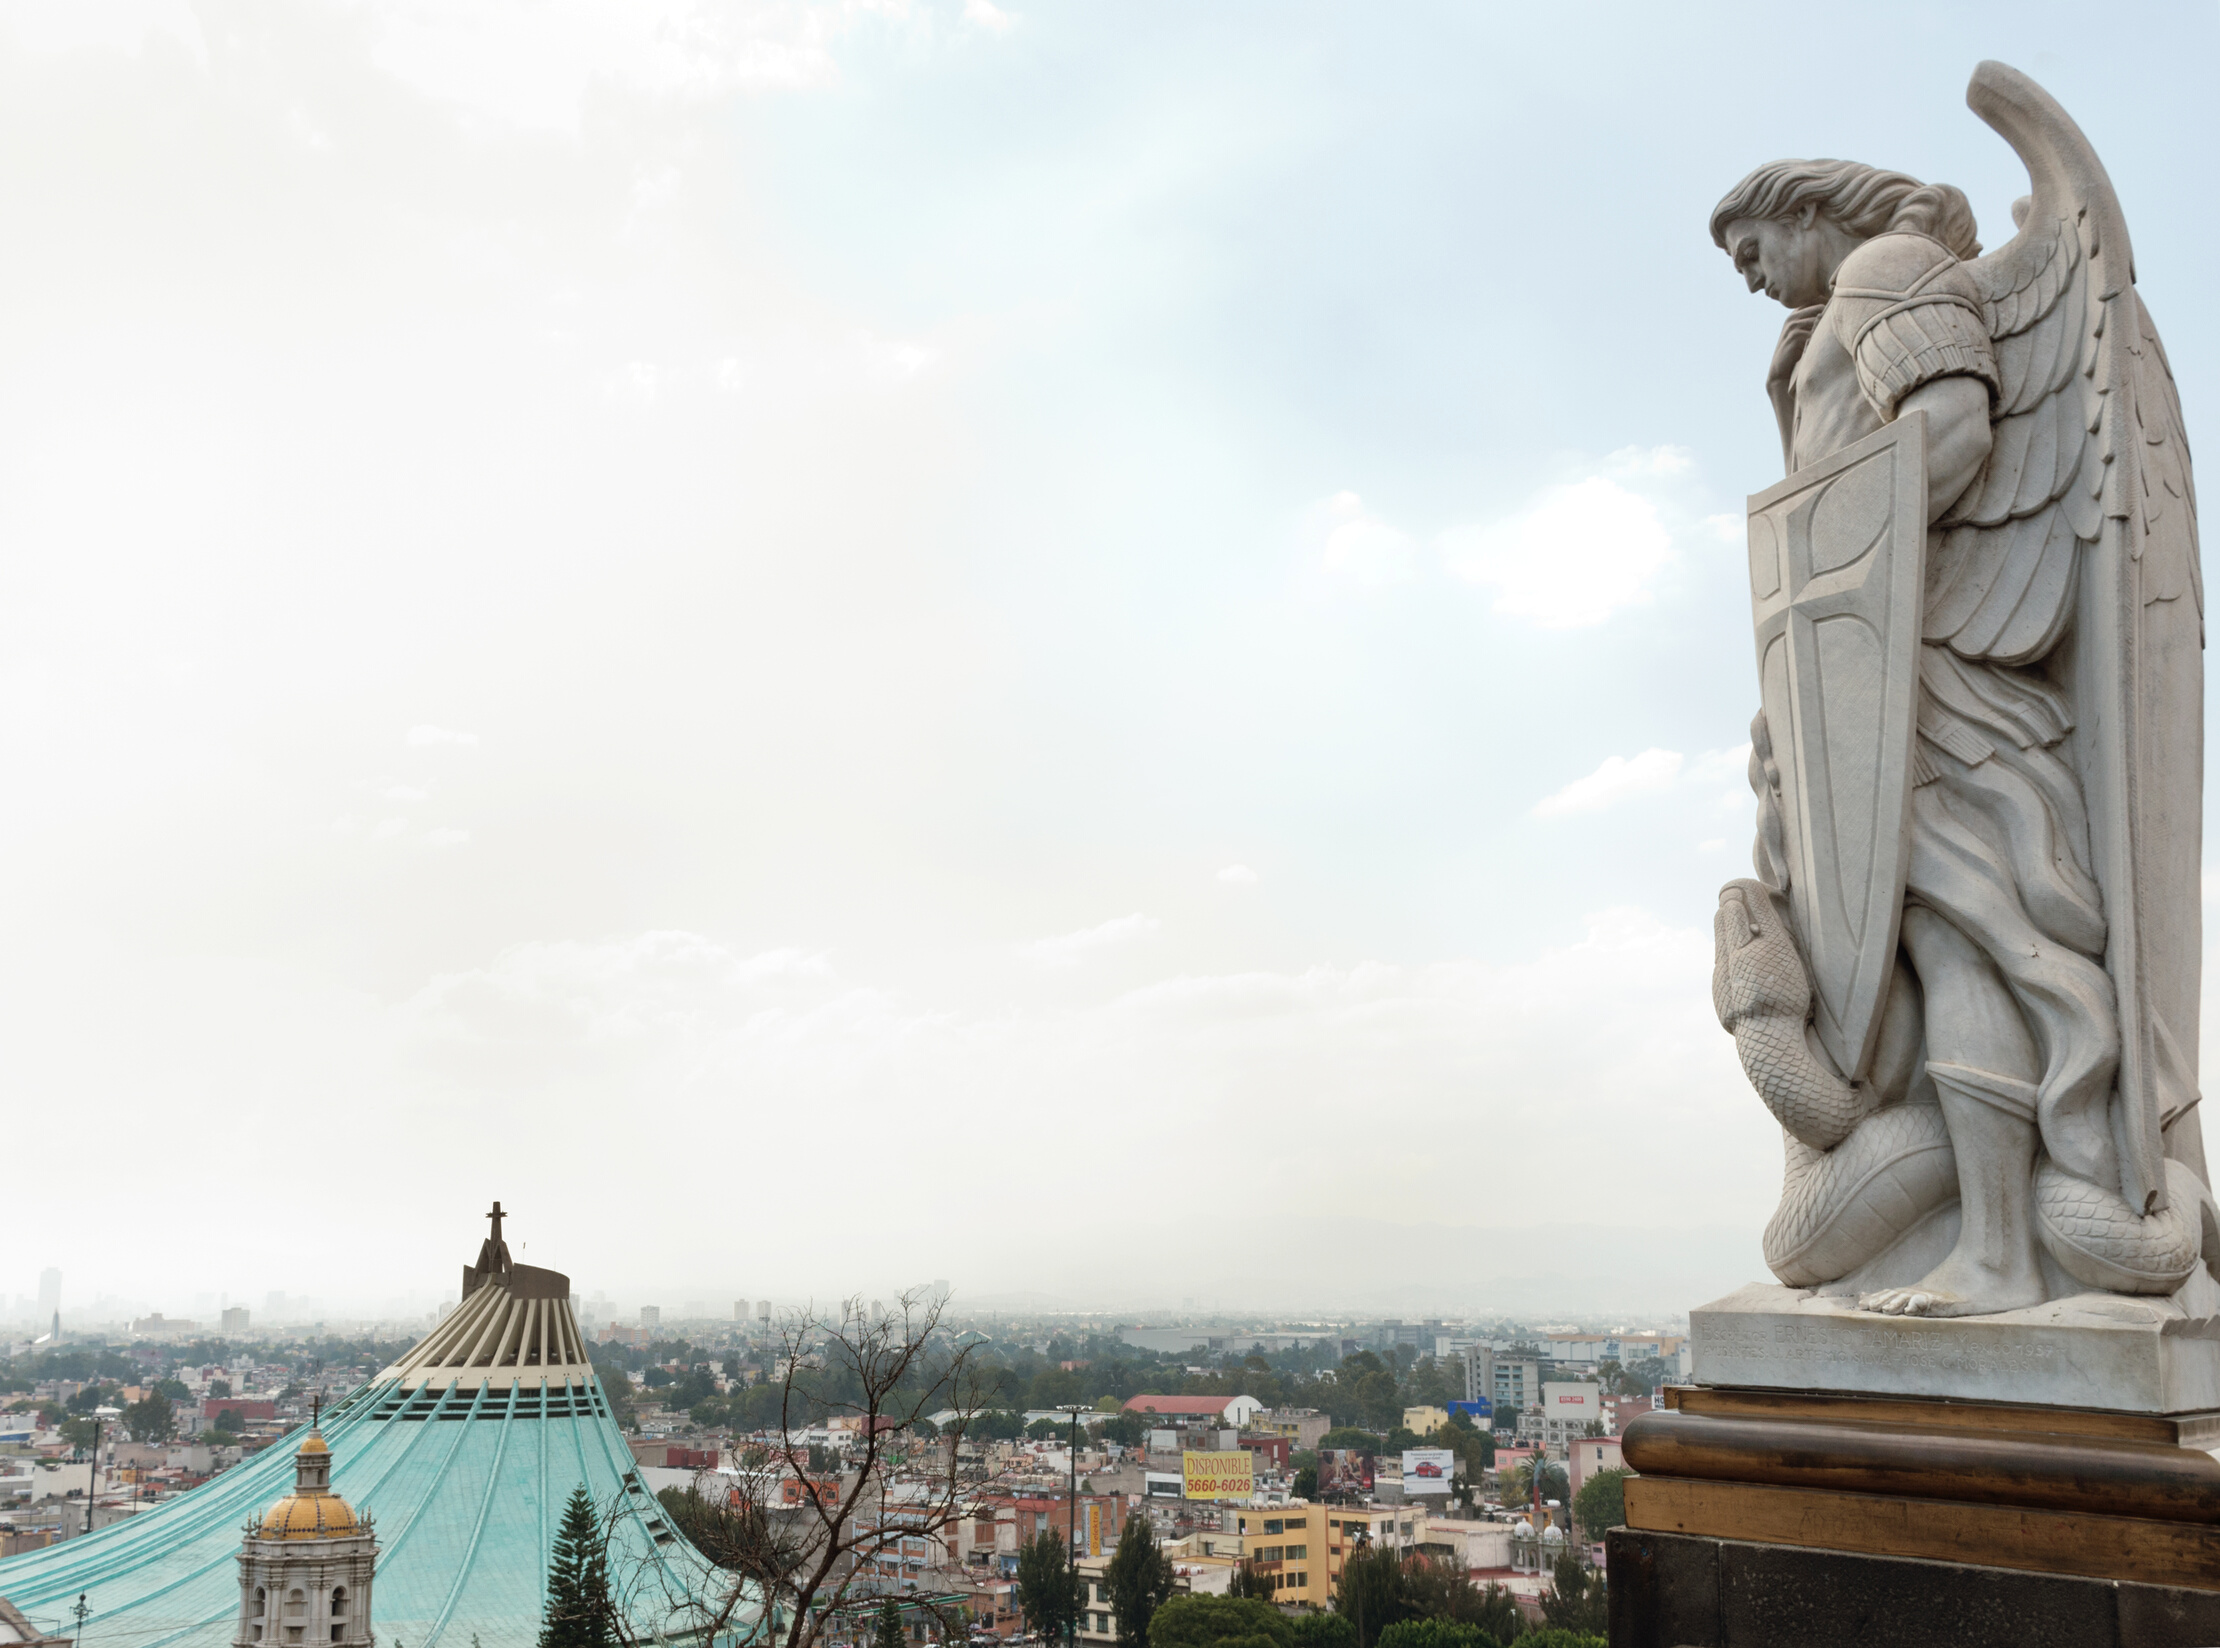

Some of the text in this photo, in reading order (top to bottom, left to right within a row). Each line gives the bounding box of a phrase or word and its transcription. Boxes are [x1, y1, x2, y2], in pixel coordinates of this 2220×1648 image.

[1774, 1324, 1853, 1346] ERNESTO
[1858, 1328, 1943, 1350] TAMARIZ
[1852, 1352, 1892, 1367] SILVA
[1957, 1357, 2031, 1374] MORALES
[1187, 1457, 1251, 1476] DISPONIBLE
[1187, 1479, 1251, 1492] 5660-6026
